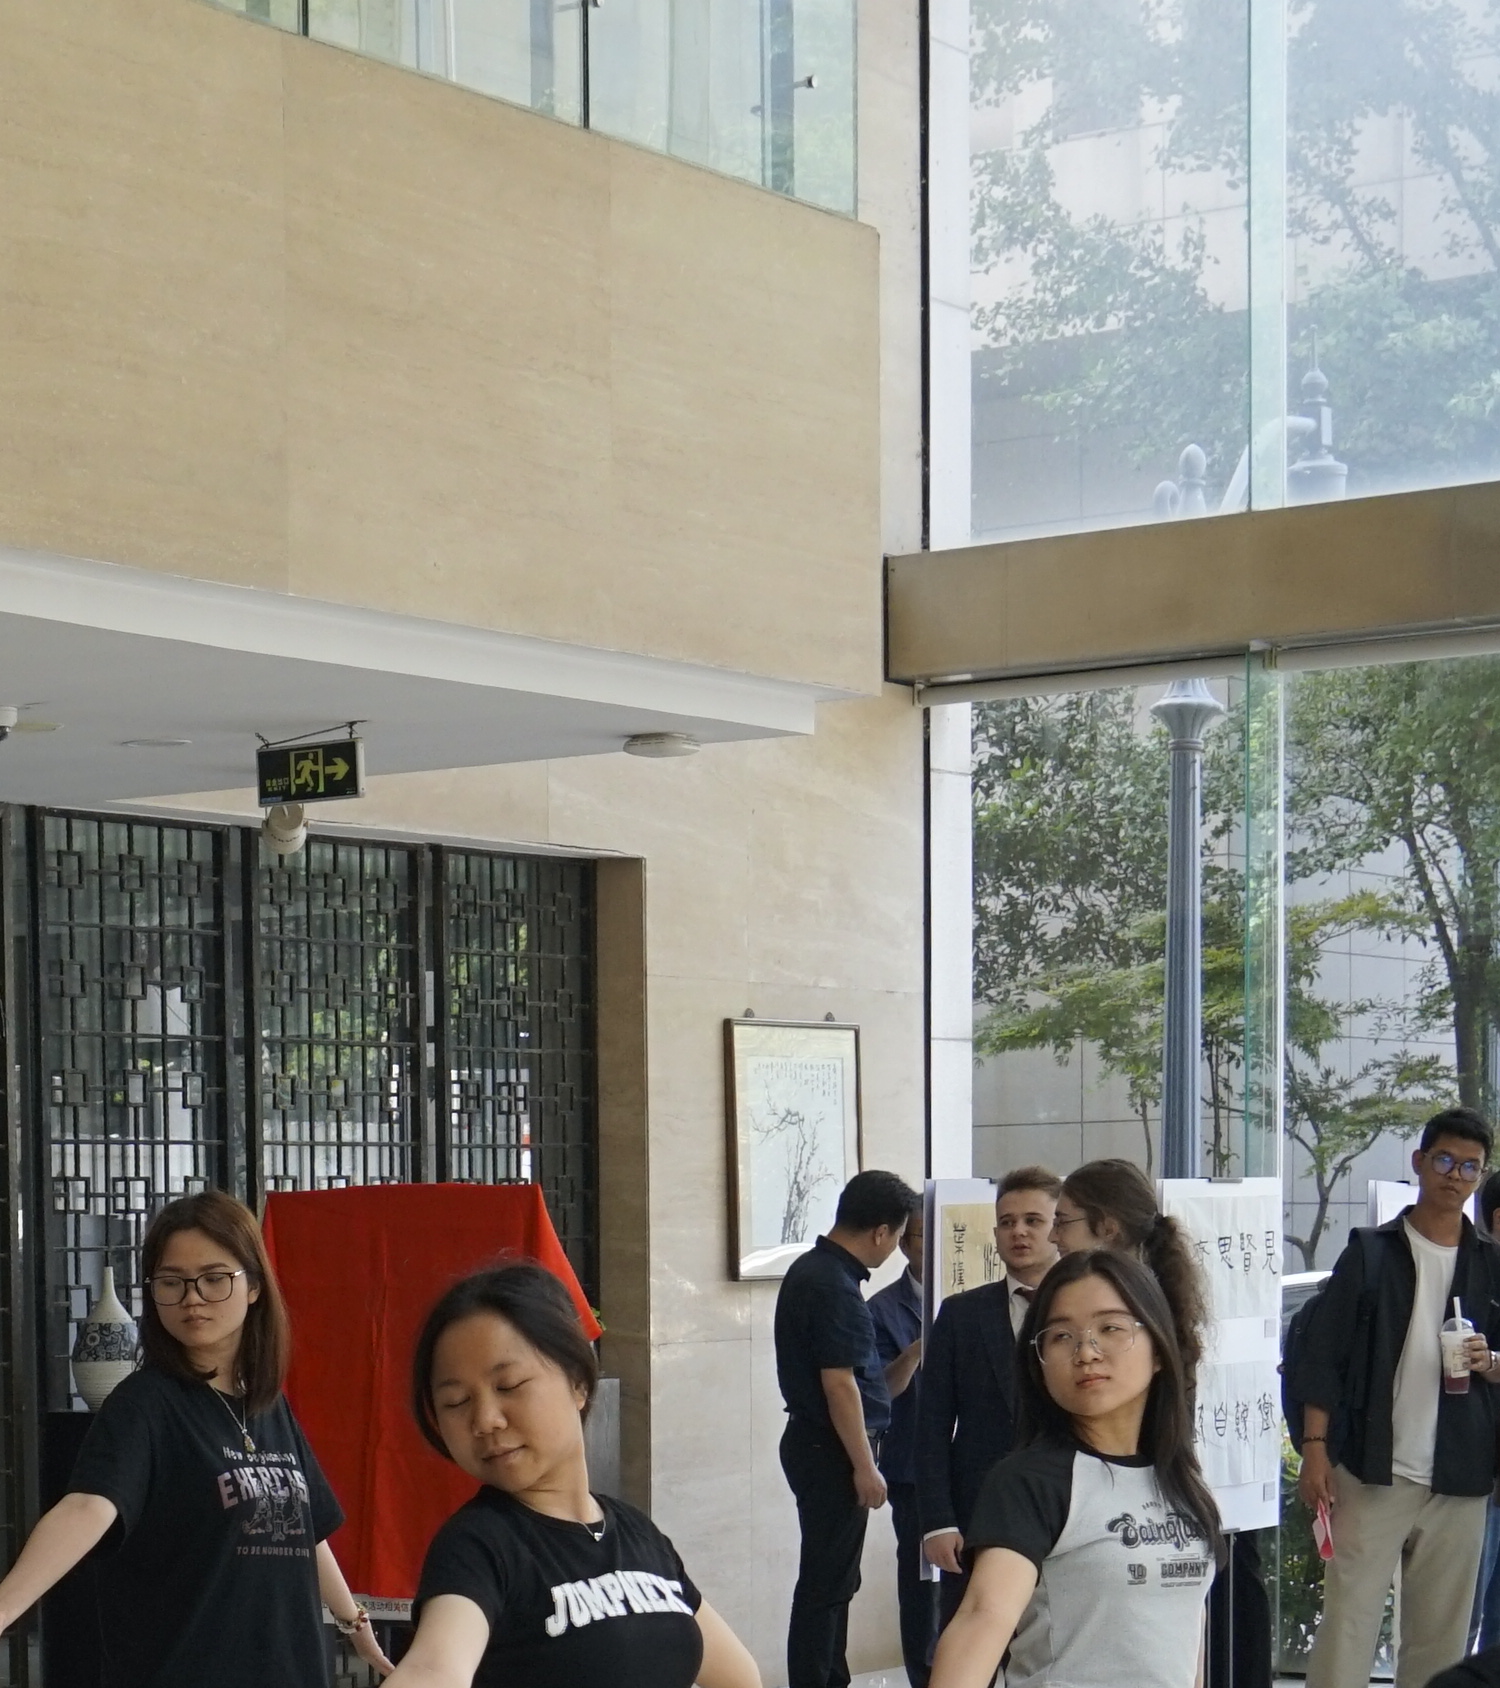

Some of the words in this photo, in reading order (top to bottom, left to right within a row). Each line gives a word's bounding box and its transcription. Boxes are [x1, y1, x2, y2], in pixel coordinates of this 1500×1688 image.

[217, 1466, 309, 1510] EXERCIS
[236, 1546, 249, 1556] TO
[262, 1546, 293, 1556] NUMBER
[1160, 1561, 1209, 1579] COMPANY
[545, 1569, 694, 1638] JUMPNEXT
